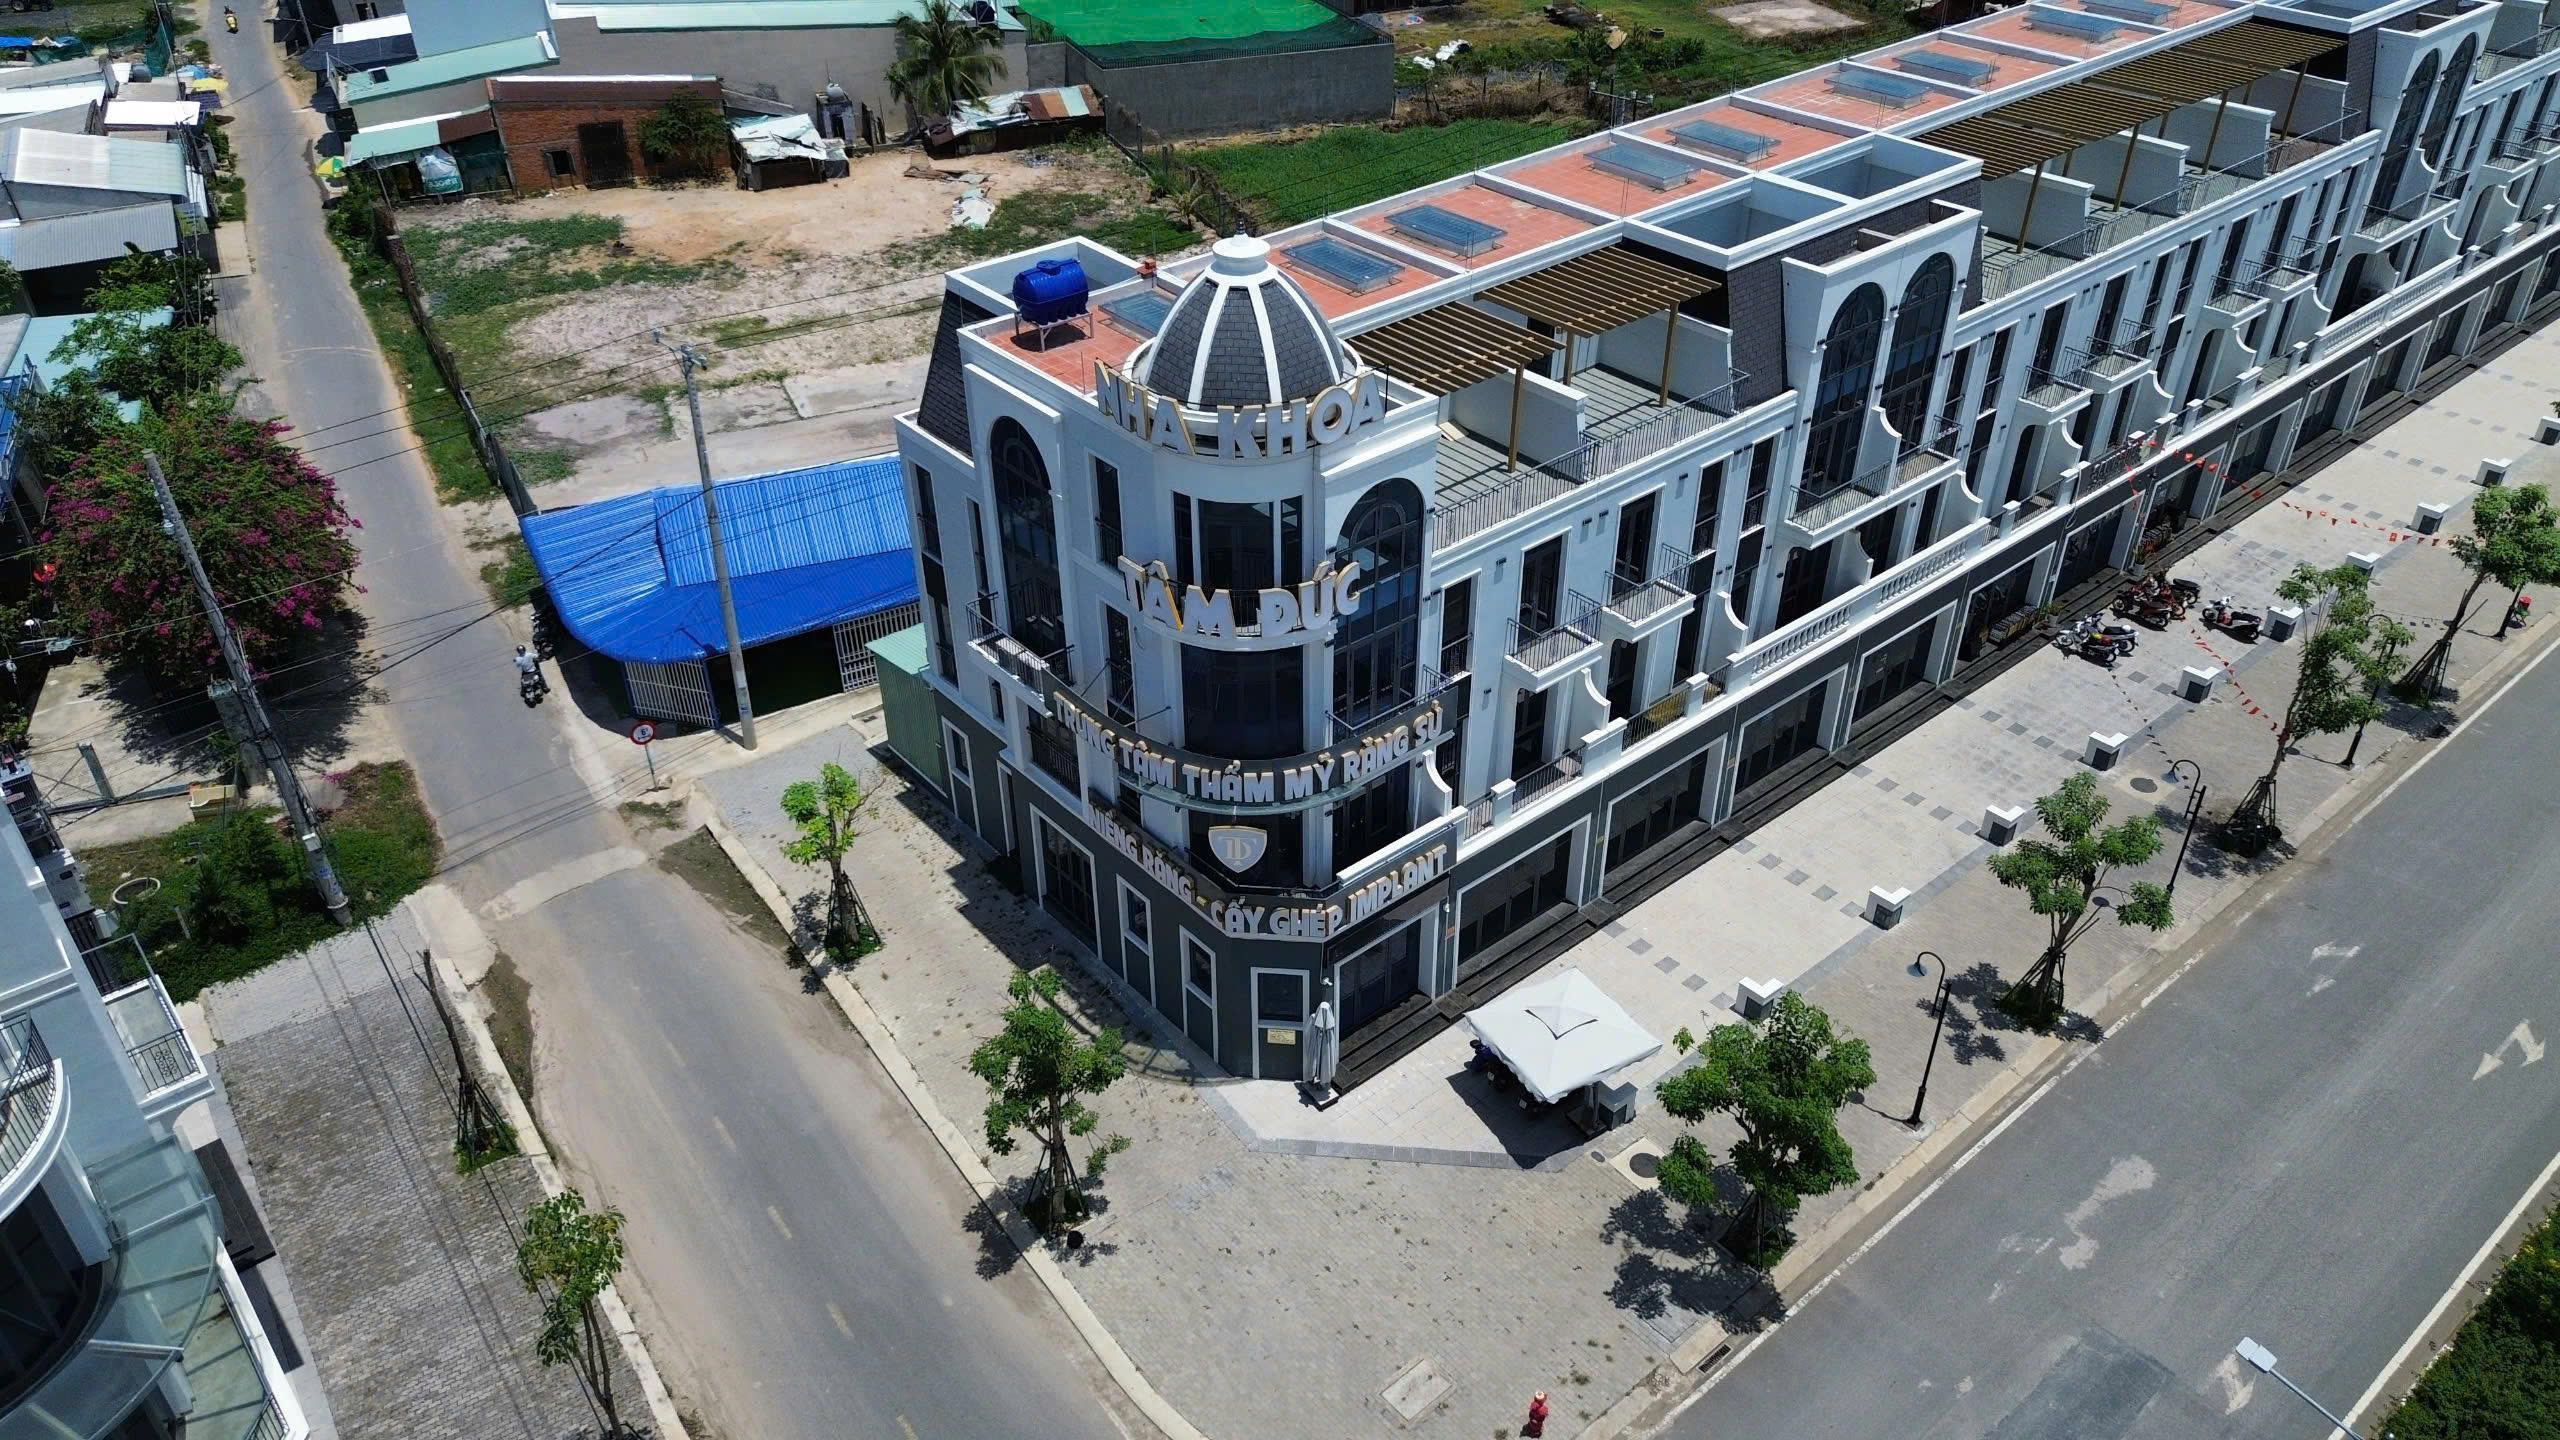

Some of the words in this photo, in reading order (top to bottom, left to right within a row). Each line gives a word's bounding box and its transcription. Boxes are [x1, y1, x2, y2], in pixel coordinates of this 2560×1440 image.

[1094, 358, 1195, 456] NHA
[1217, 371, 1387, 459] KHOA
[1118, 555, 1236, 639] TÂM
[1256, 560, 1360, 637] ĐỨC
[1053, 691, 1116, 760] TRUNG
[1119, 738, 1176, 789] TÂM
[1182, 760, 1275, 802] THẨM
[1283, 752, 1335, 800] MỸ
[1341, 726, 1409, 783] RĂNG
[1211, 896, 1265, 935] CẤY
[1269, 903, 1343, 937] GHÉP
[1348, 844, 1447, 924] IMPLANT
